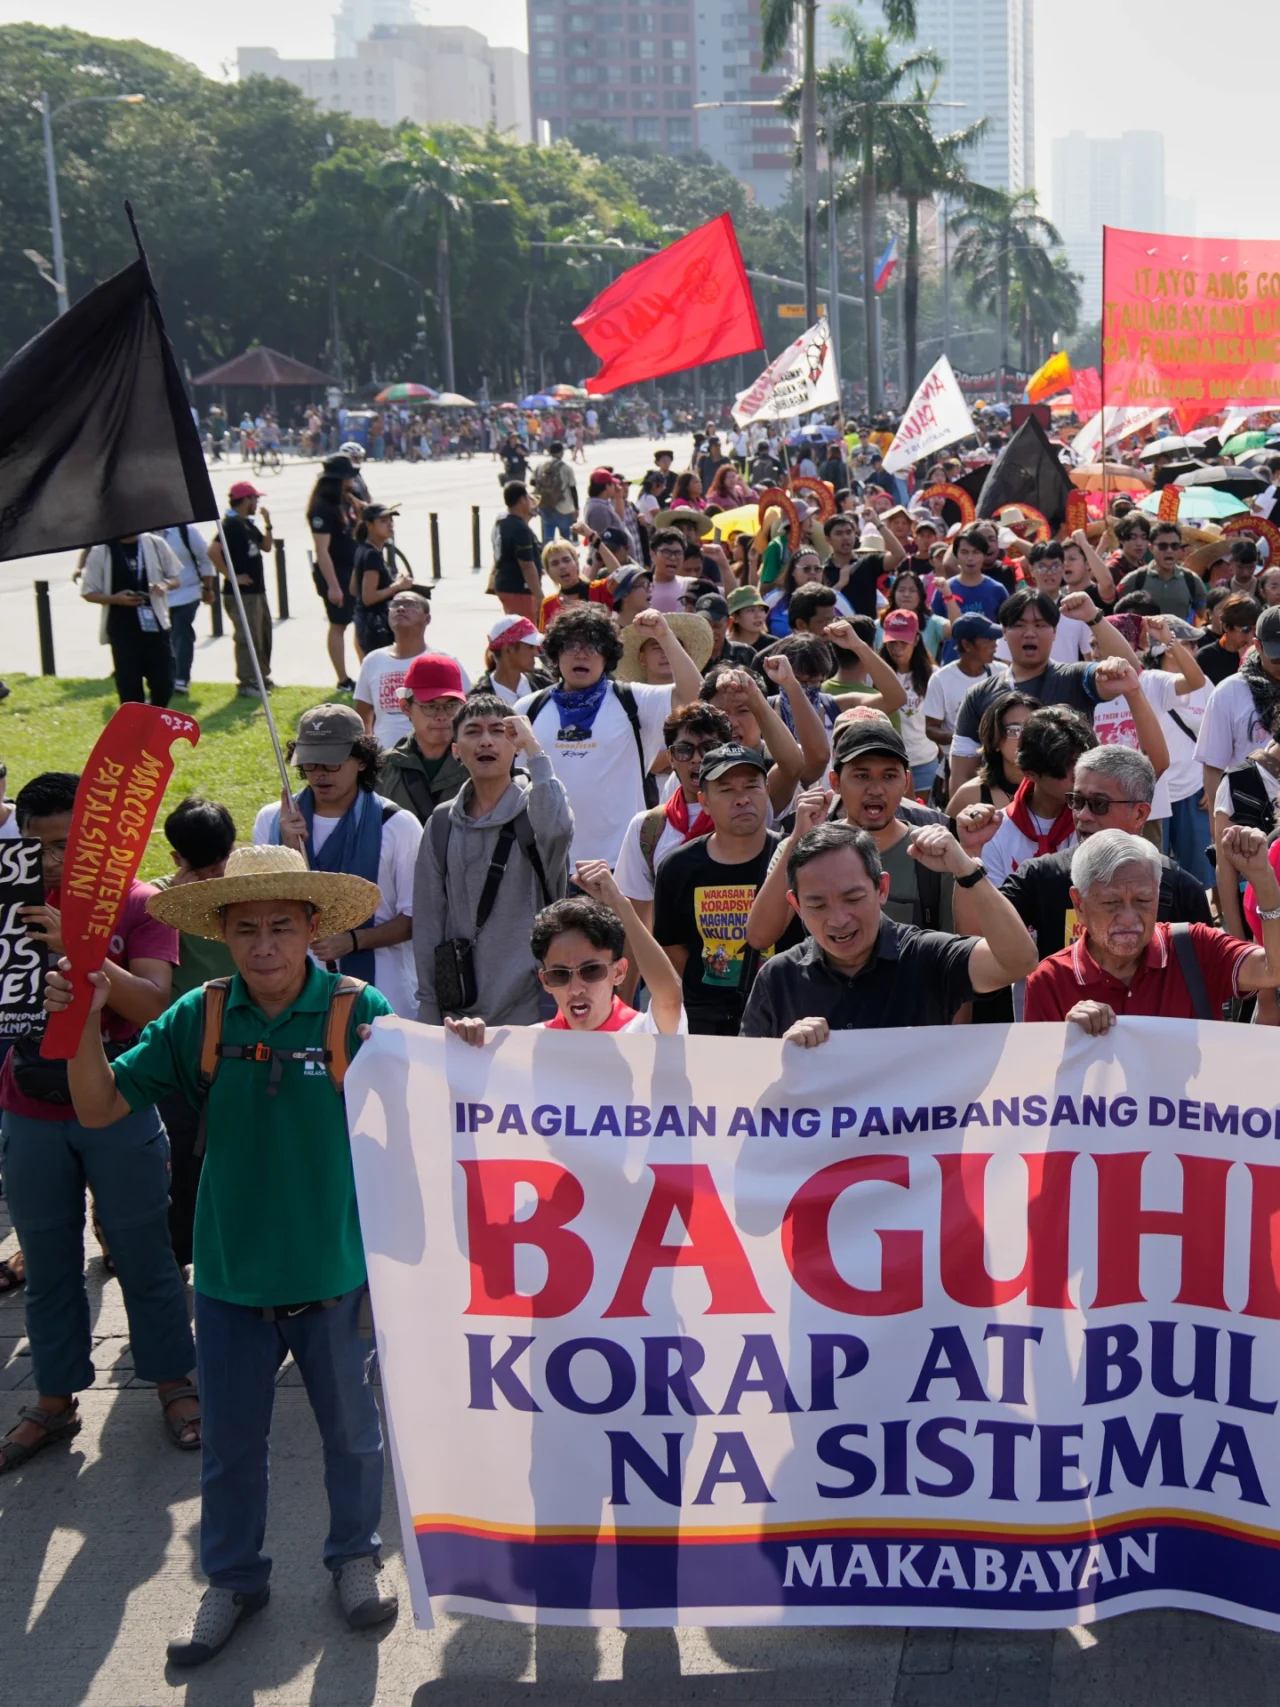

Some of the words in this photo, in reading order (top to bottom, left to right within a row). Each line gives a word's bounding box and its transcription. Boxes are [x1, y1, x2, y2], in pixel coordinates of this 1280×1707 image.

[1134, 267, 1196, 297] ITAYO
[1205, 271, 1249, 299] ANG
[1105, 303, 1244, 333] TAUMBAYAN!
[1102, 337, 1130, 363] SA
[1128, 376, 1204, 400] KILUSANG
[66, 756, 126, 900] PATALSIKIN!
[81, 749, 165, 941] MARCOS-DUTERTE,
[0, 842, 42, 886] SE
[703, 889, 745, 900] WAKASAN
[0, 967, 42, 1004] E!
[454, 1098, 717, 1138] IPAGLABAN
[726, 1101, 821, 1141] ANG
[829, 1093, 1140, 1141] PAMBANSANG
[465, 1333, 868, 1417] KORAP
[907, 1323, 1041, 1405] AT
[606, 1428, 777, 1508] NA
[782, 1530, 1160, 1596] MAKABAYAN
